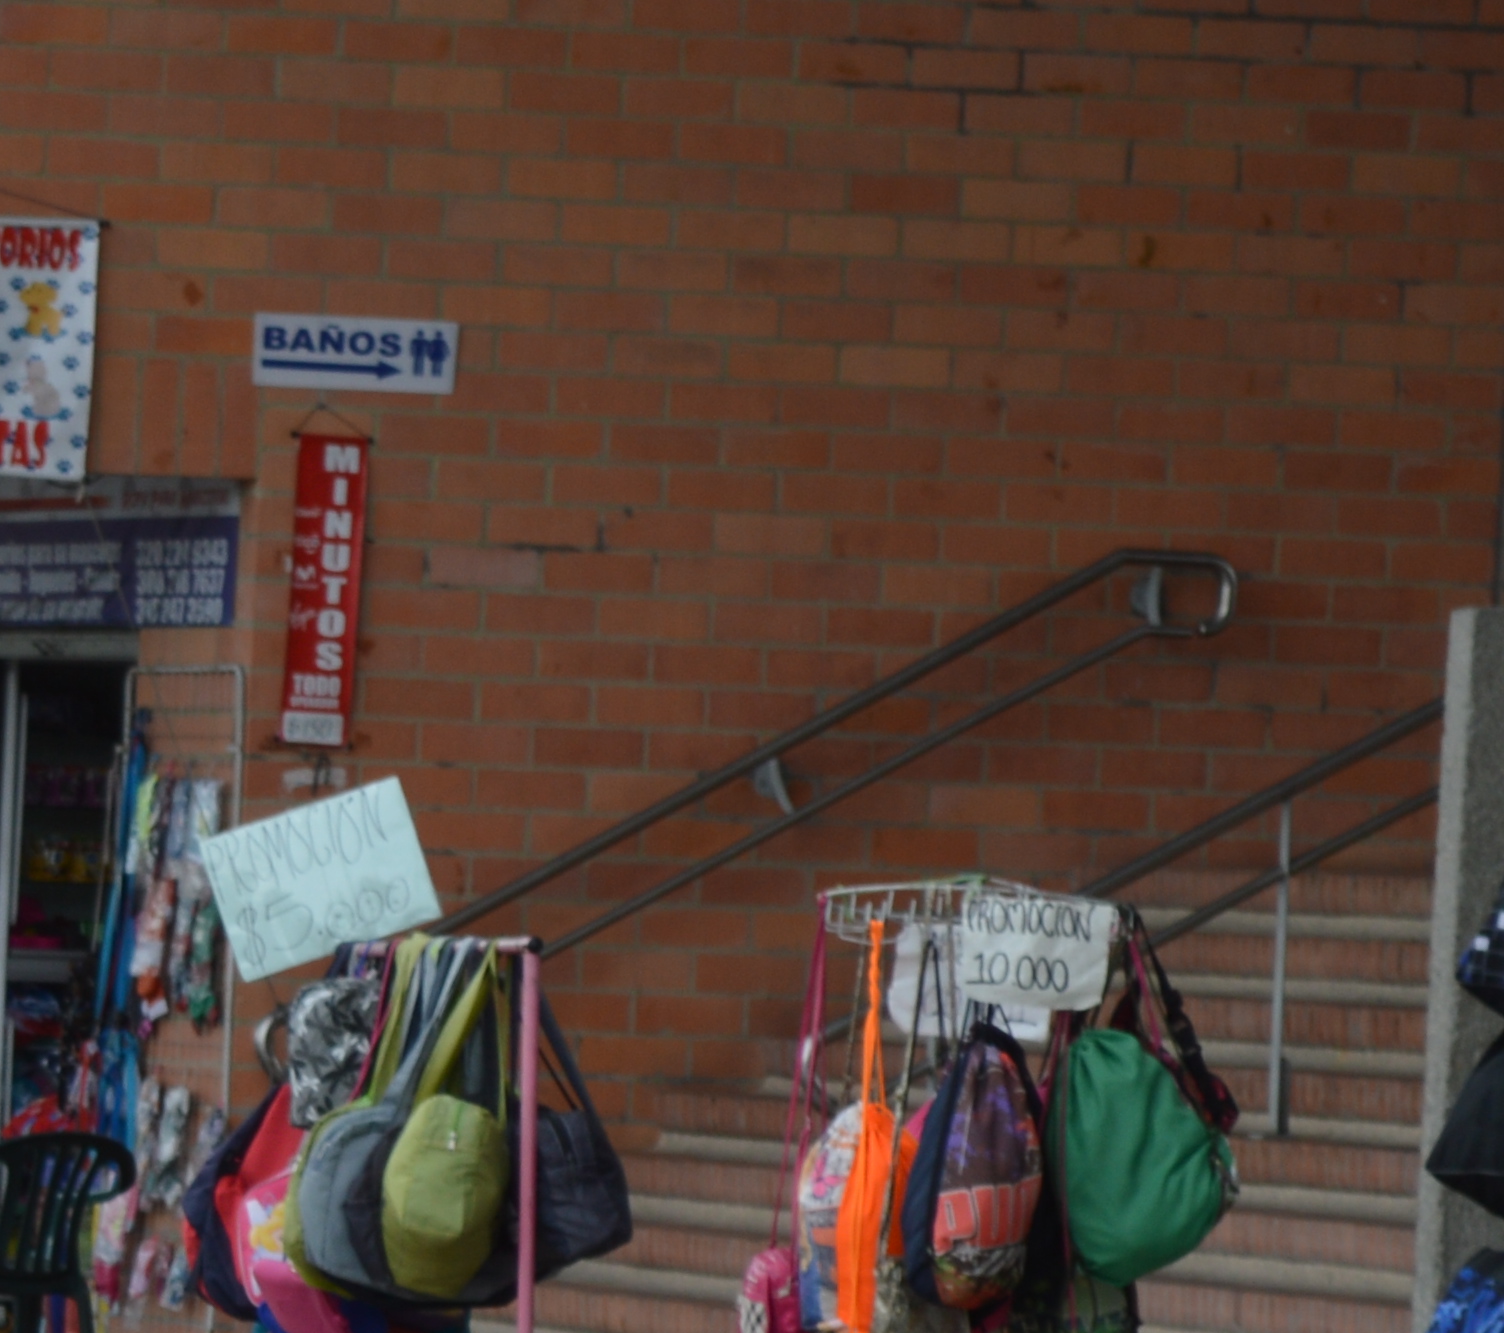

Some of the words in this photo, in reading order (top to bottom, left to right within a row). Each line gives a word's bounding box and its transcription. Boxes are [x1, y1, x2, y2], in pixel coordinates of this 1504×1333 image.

[263, 324, 402, 358] BAÑOS
[314, 443, 361, 671] MINUTOS
[291, 673, 342, 698] TODO
